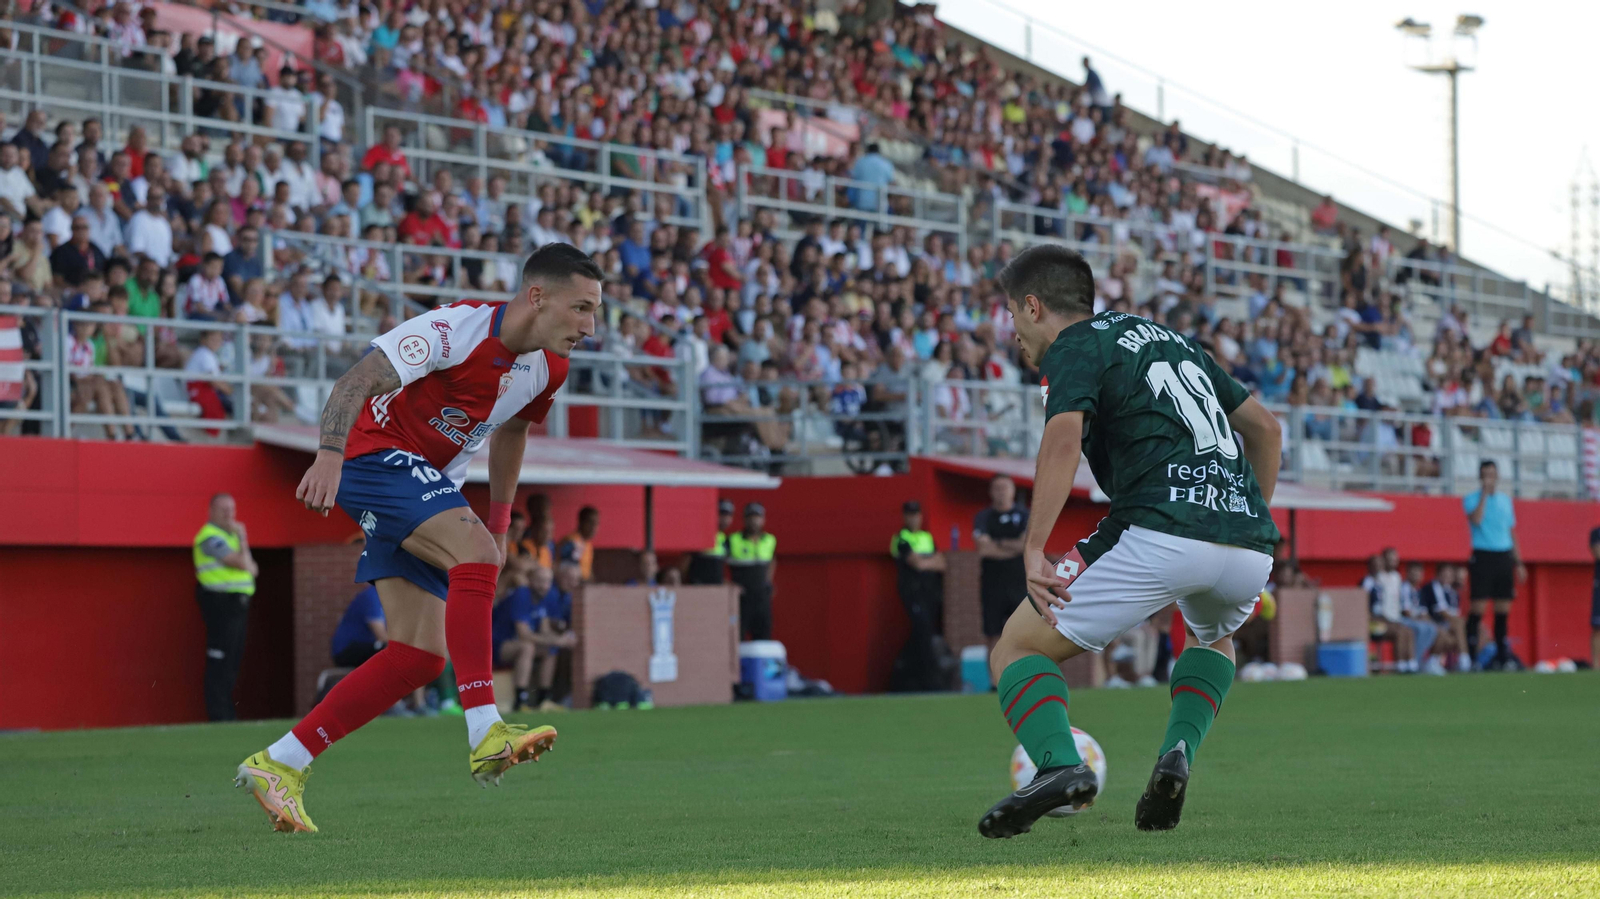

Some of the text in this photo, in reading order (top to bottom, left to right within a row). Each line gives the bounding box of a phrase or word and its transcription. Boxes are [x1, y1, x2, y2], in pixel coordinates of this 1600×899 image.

[1117, 323, 1170, 354] BRAIS
[493, 357, 531, 373] GIVOVA
[1145, 360, 1239, 460] 18
[411, 466, 442, 484] 16
